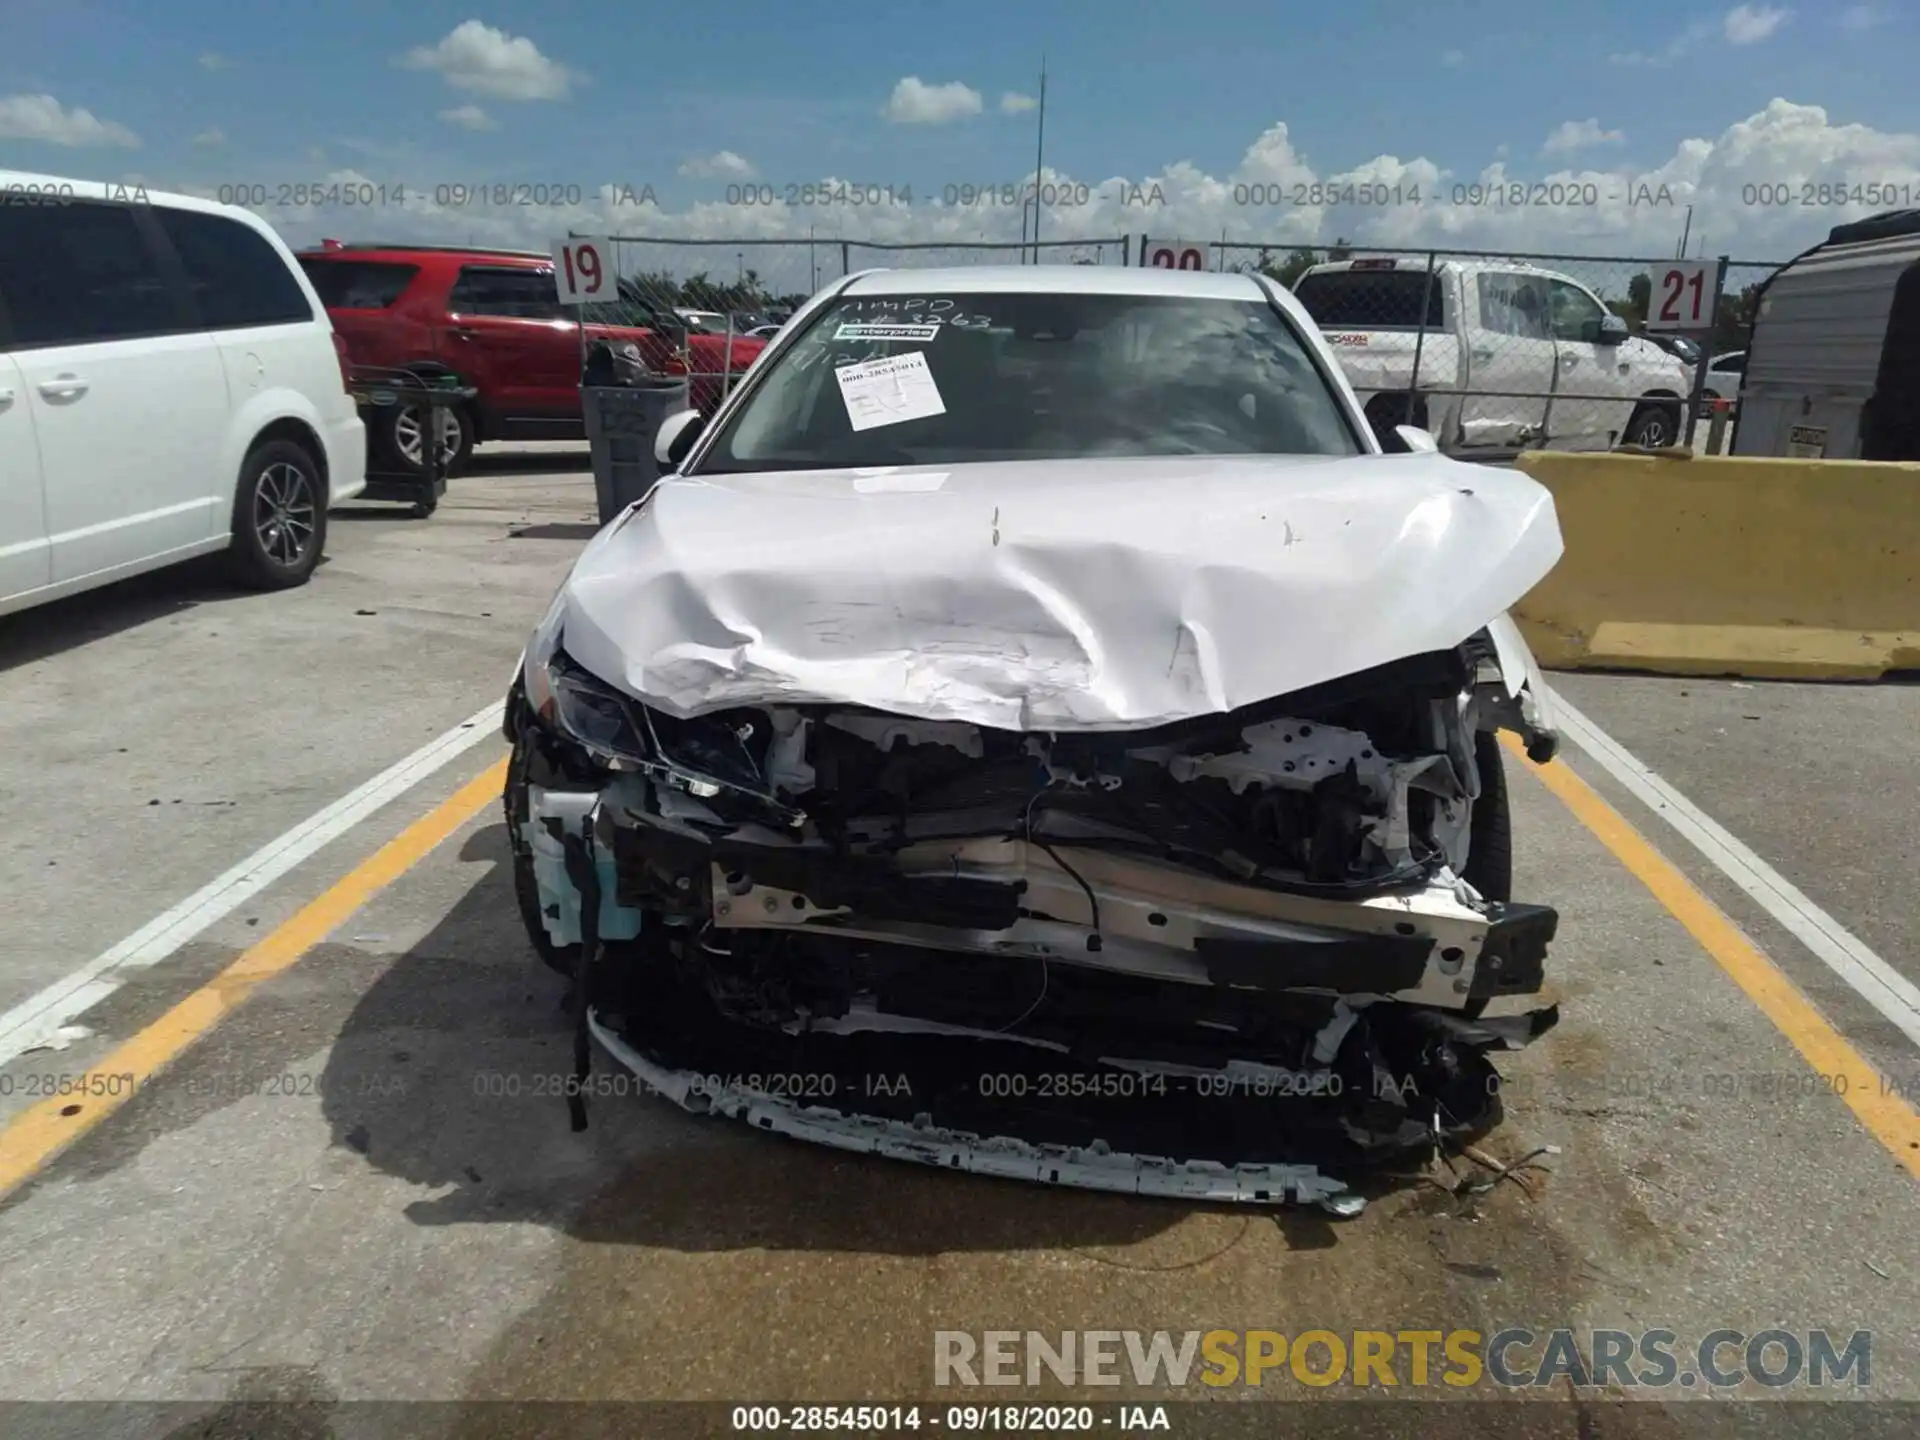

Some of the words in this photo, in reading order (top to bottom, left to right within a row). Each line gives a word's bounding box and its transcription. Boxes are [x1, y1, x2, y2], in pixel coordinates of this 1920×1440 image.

[562, 244, 602, 294] 19
[1659, 269, 1704, 321] 21
[844, 327, 932, 337] enterprise
[842, 360, 923, 383] 000-28545014
